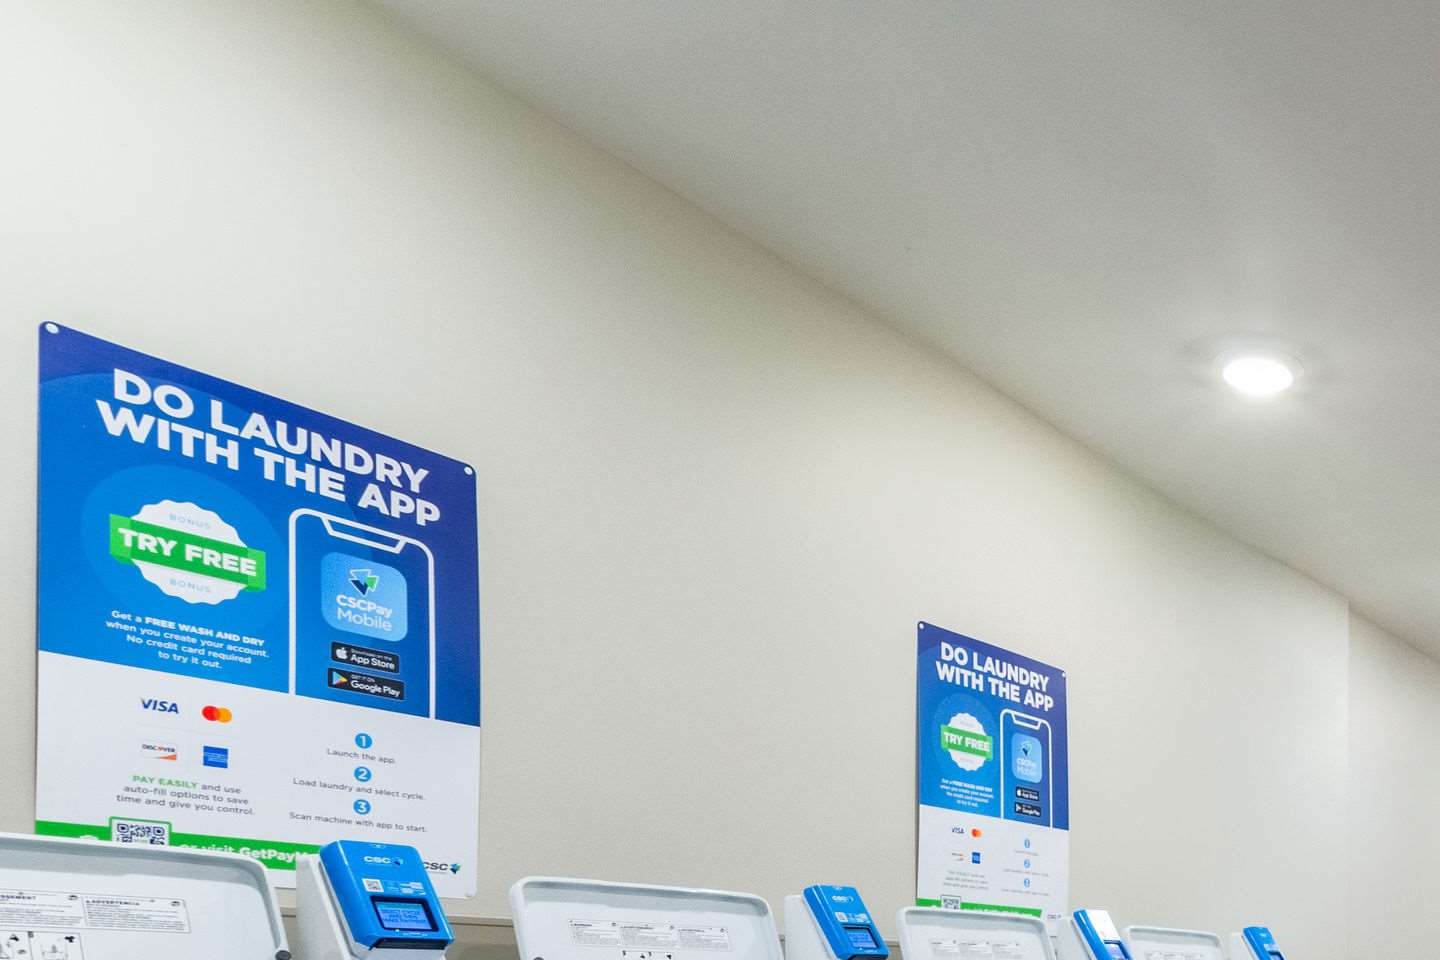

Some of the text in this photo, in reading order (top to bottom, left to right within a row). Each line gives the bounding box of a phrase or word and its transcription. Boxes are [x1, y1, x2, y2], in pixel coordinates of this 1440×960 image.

[114, 368, 429, 493] DO LAUNDRY
[95, 400, 440, 527] WITH THE APP
[169, 514, 211, 530] BONUS
[118, 527, 257, 577] TRY FREE
[169, 578, 211, 593] BONUS
[336, 594, 392, 618] CSCPay
[112, 610, 264, 647] Get a FREE WASH AND DRY
[337, 607, 392, 631] Mobile
[106, 621, 269, 658] when you create your account.
[127, 634, 252, 664] No credit card required
[158, 651, 222, 669] to try it out.
[350, 654, 395, 671] App Store
[941, 641, 1049, 692] DO LAUNDRY
[350, 680, 400, 697] Google Play
[936, 660, 1054, 712] WITH THE APP
[141, 698, 179, 714] VISA
[360, 735, 366, 747] 1
[943, 732, 990, 752] TRY FREE
[326, 748, 359, 758] Launch
[362, 753, 376, 761] the
[357, 768, 367, 780] 2
[132, 775, 242, 794] PAY EASILY and use
[293, 778, 317, 787] Load
[320, 781, 353, 792] laundry
[356, 786, 372, 794] and
[374, 788, 400, 797] select
[123, 785, 249, 805] auto-fill options to save
[116, 795, 141, 804] time
[144, 797, 166, 806] and
[169, 800, 191, 809] give
[216, 805, 255, 815] control.
[357, 801, 367, 813] 3
[289, 812, 312, 820] Scan
[314, 815, 353, 825] machine
[355, 819, 374, 827] with
[376, 822, 392, 830] app
[363, 855, 391, 864] CSC
